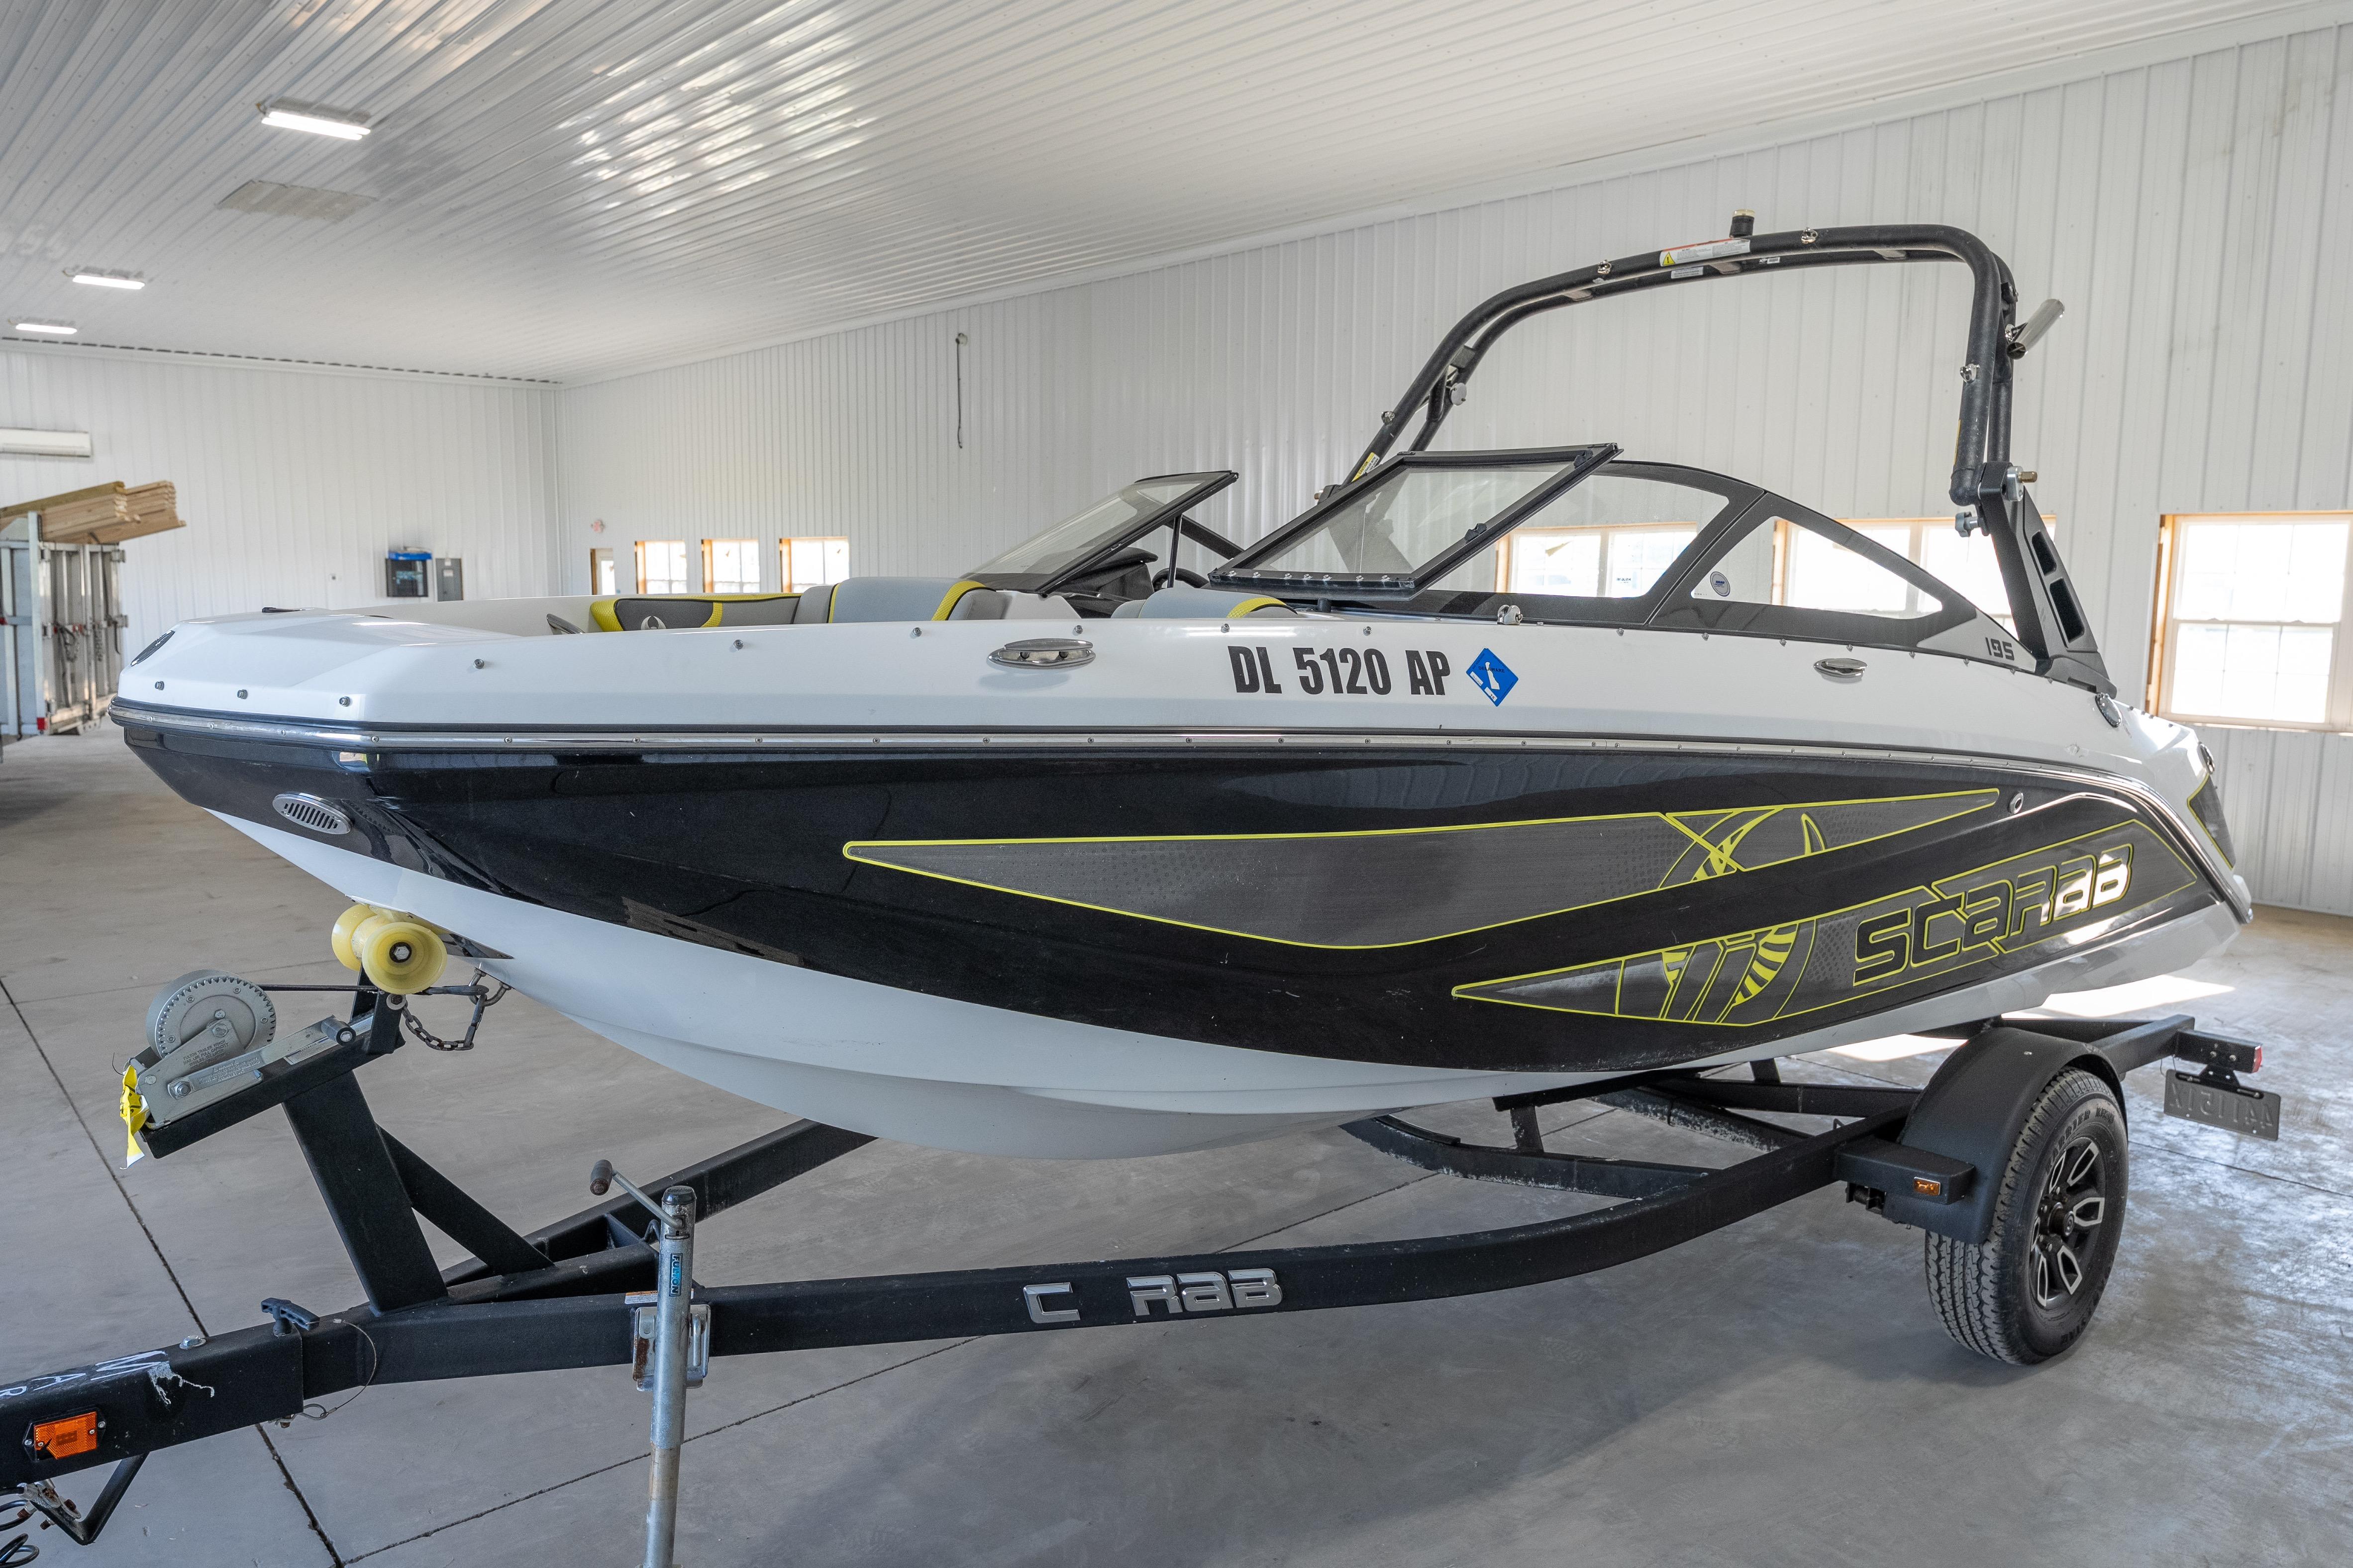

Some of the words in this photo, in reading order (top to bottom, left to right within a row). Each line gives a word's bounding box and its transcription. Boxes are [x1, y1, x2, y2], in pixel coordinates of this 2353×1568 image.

[1358, 461, 1368, 474] CAUTION
[1985, 637, 2015, 661] 195
[1228, 646, 1282, 694] DL
[1293, 647, 1392, 695] 5120
[1405, 650, 1451, 696] AP
[1853, 842, 2134, 986] SCARAB
[183, 1052, 197, 1061] FULTON
[198, 1046, 212, 1055] TRAILER
[211, 1043, 228, 1053] CAPACITY
[671, 1254, 681, 1294] FULTON
